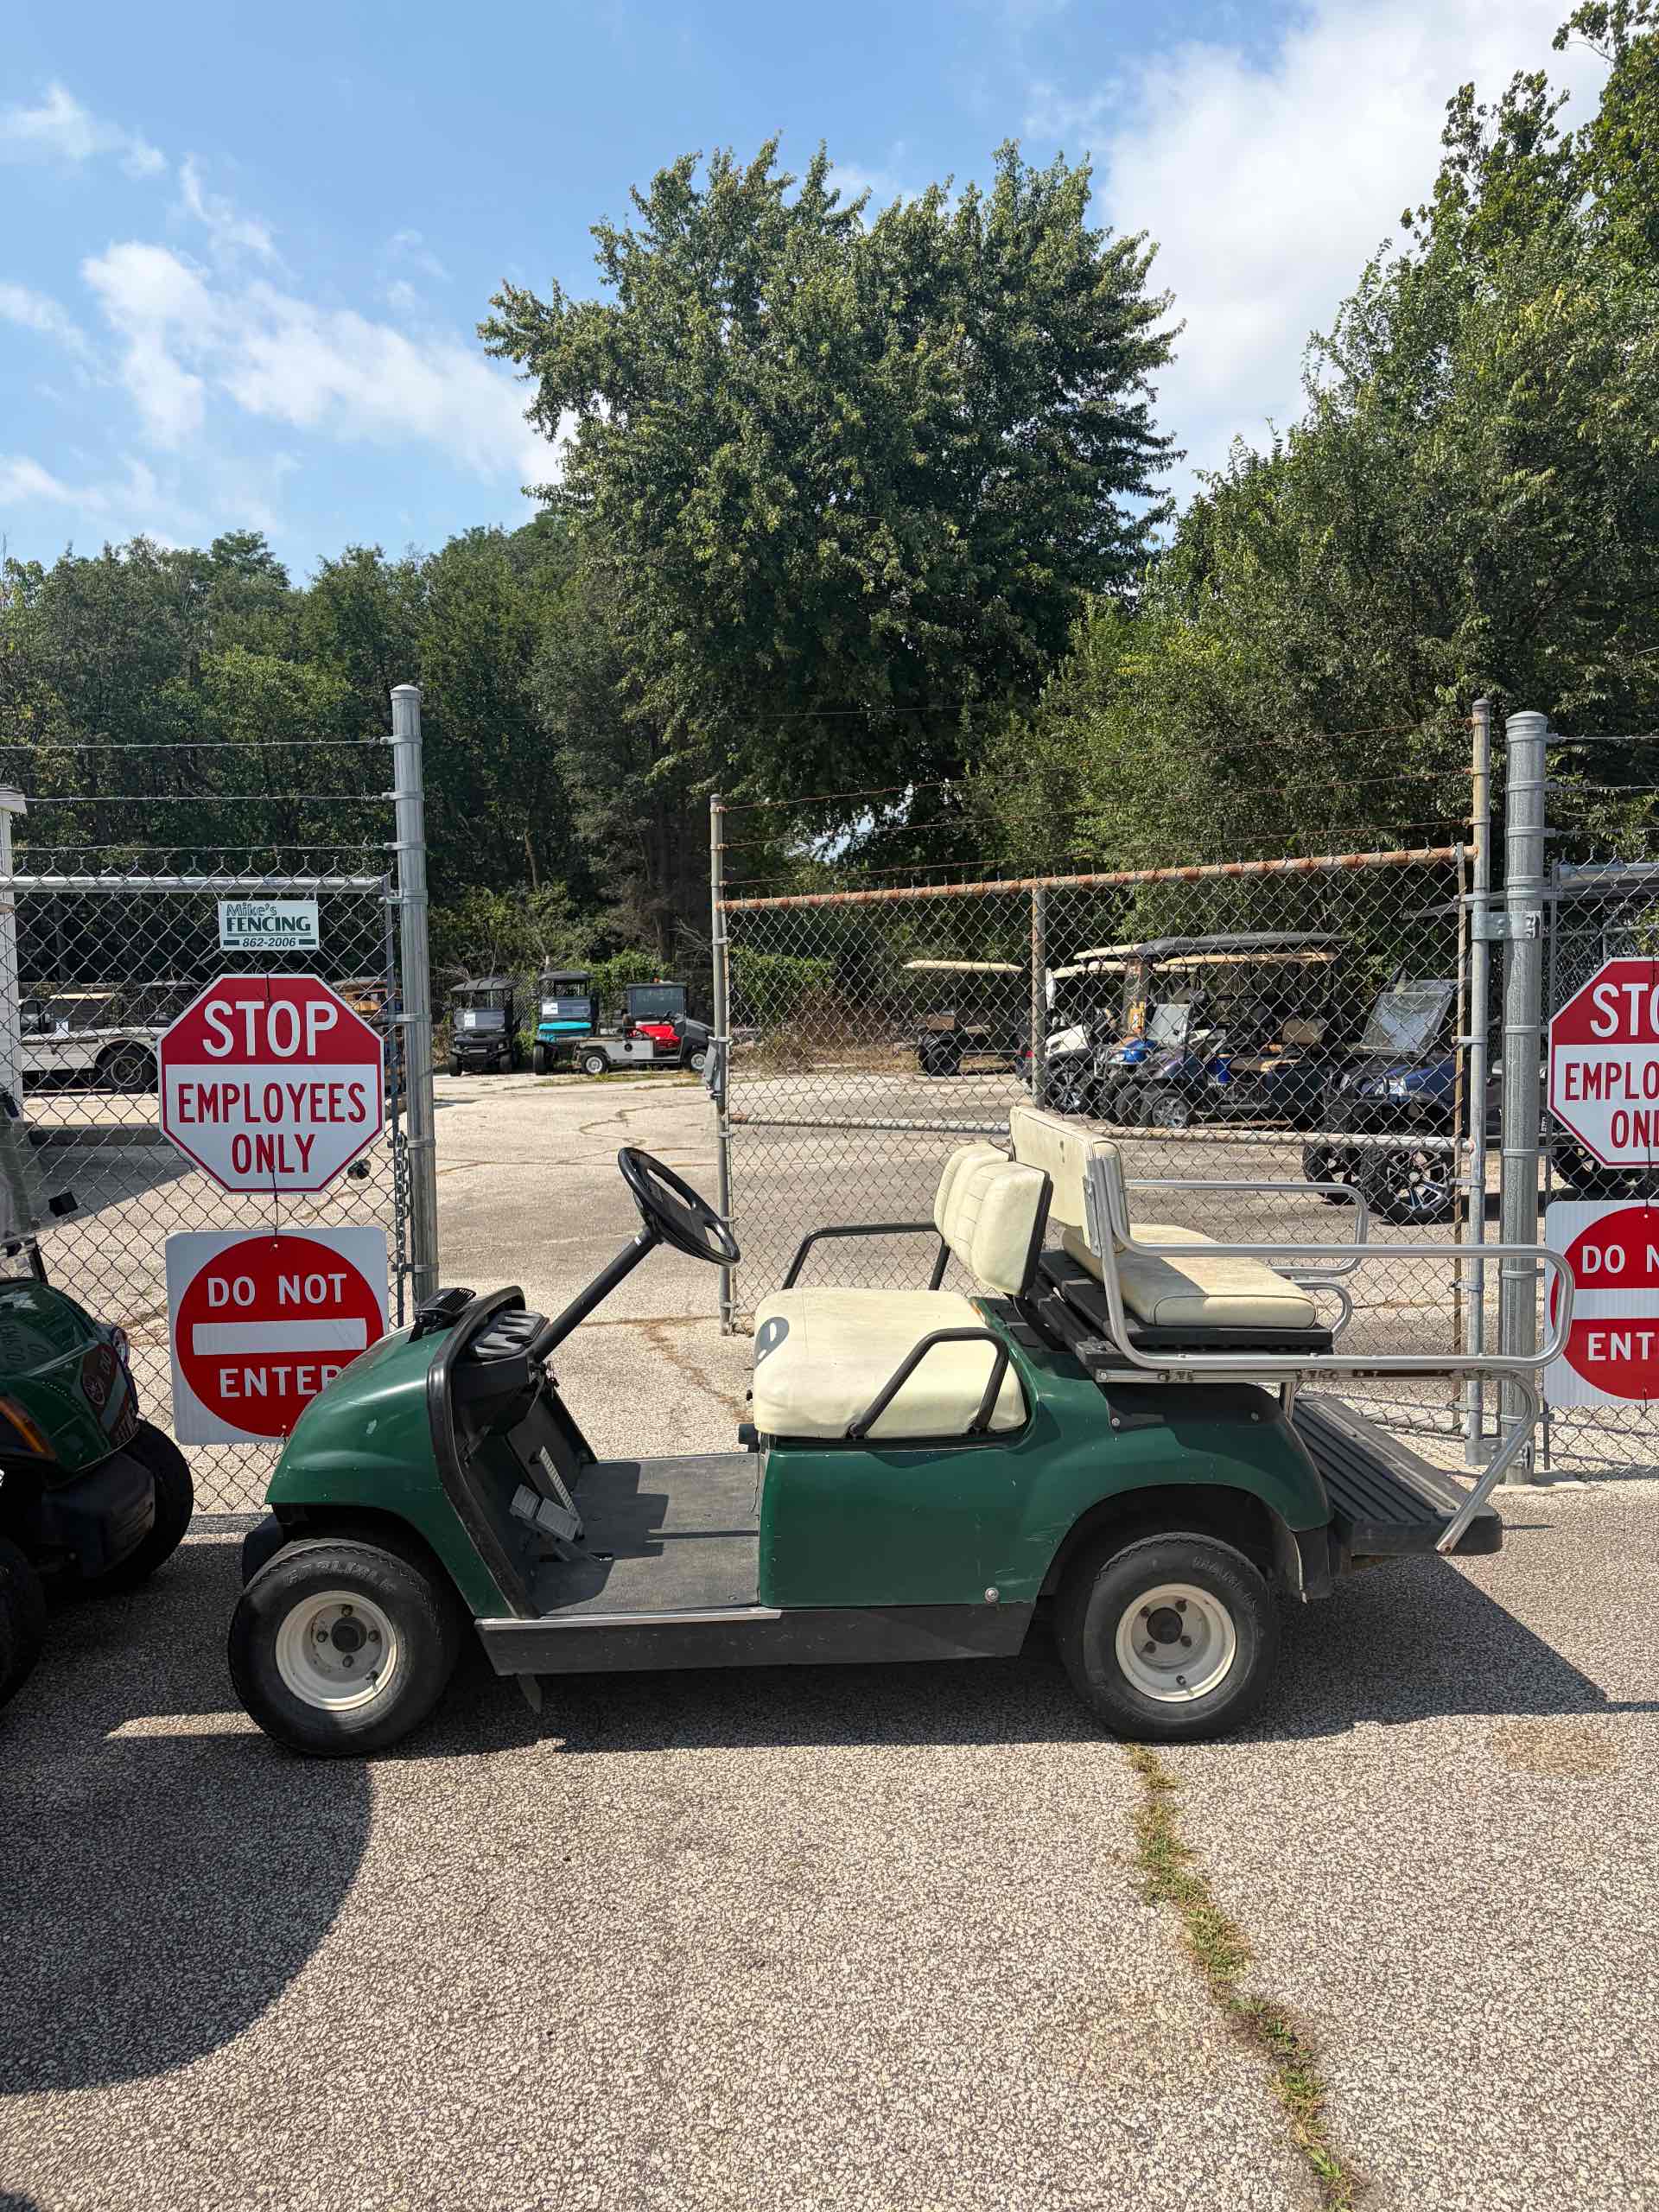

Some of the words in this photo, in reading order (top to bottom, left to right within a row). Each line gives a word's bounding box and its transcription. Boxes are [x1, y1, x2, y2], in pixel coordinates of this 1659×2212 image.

[226, 902, 277, 916] Mike's
[226, 917, 311, 932] FENCING
[243, 938, 296, 947] 862-2006
[1590, 983, 1659, 1038] ST
[202, 1001, 339, 1058] STOP
[177, 1083, 366, 1123] EMPLOYEES
[232, 1133, 316, 1174] ONLY
[1582, 1244, 1625, 1274] DO
[207, 1276, 256, 1307] DO
[278, 1274, 347, 1305] NOT
[1587, 1332, 1656, 1361] ENT
